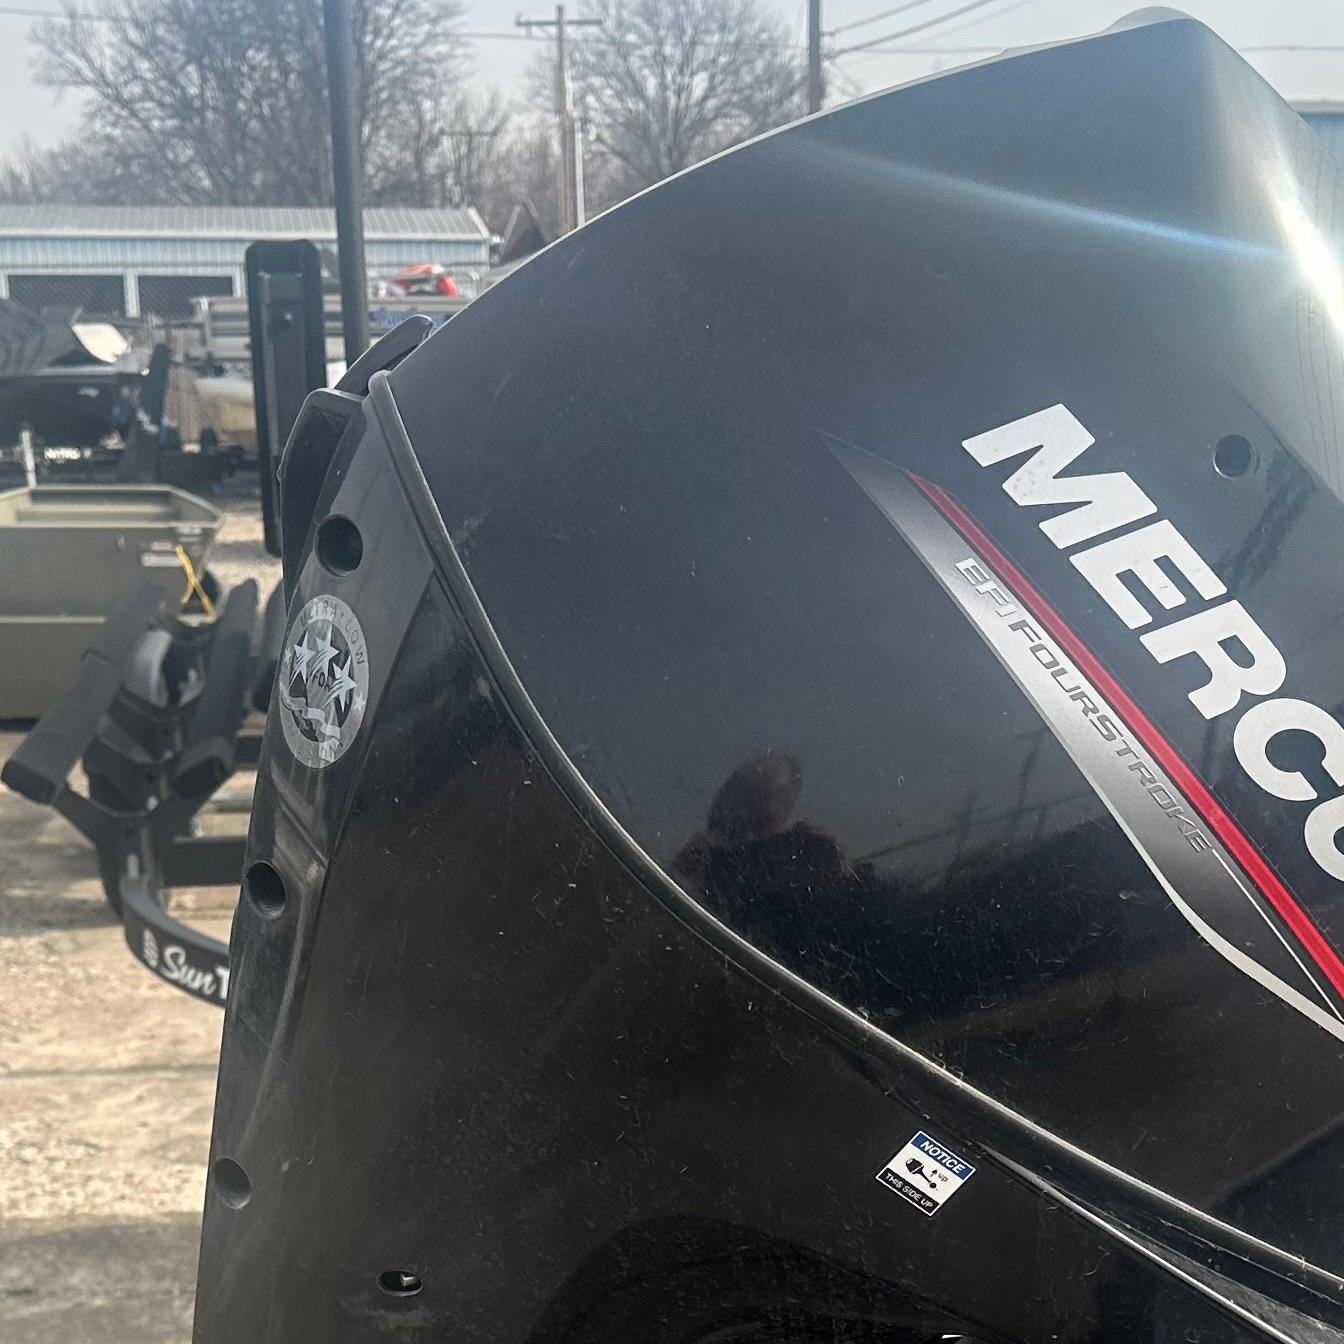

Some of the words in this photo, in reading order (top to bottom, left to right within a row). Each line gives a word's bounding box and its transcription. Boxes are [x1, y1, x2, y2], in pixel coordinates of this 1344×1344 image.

[955, 557, 1018, 618] EFI
[1008, 619, 1213, 853] FOURSTROKE
[159, 945, 217, 995] Sun
[920, 1141, 966, 1173] NOTICE
[885, 1172, 904, 1188] THIS
[902, 1185, 922, 1201] SIDE
[921, 1198, 933, 1207] UP
